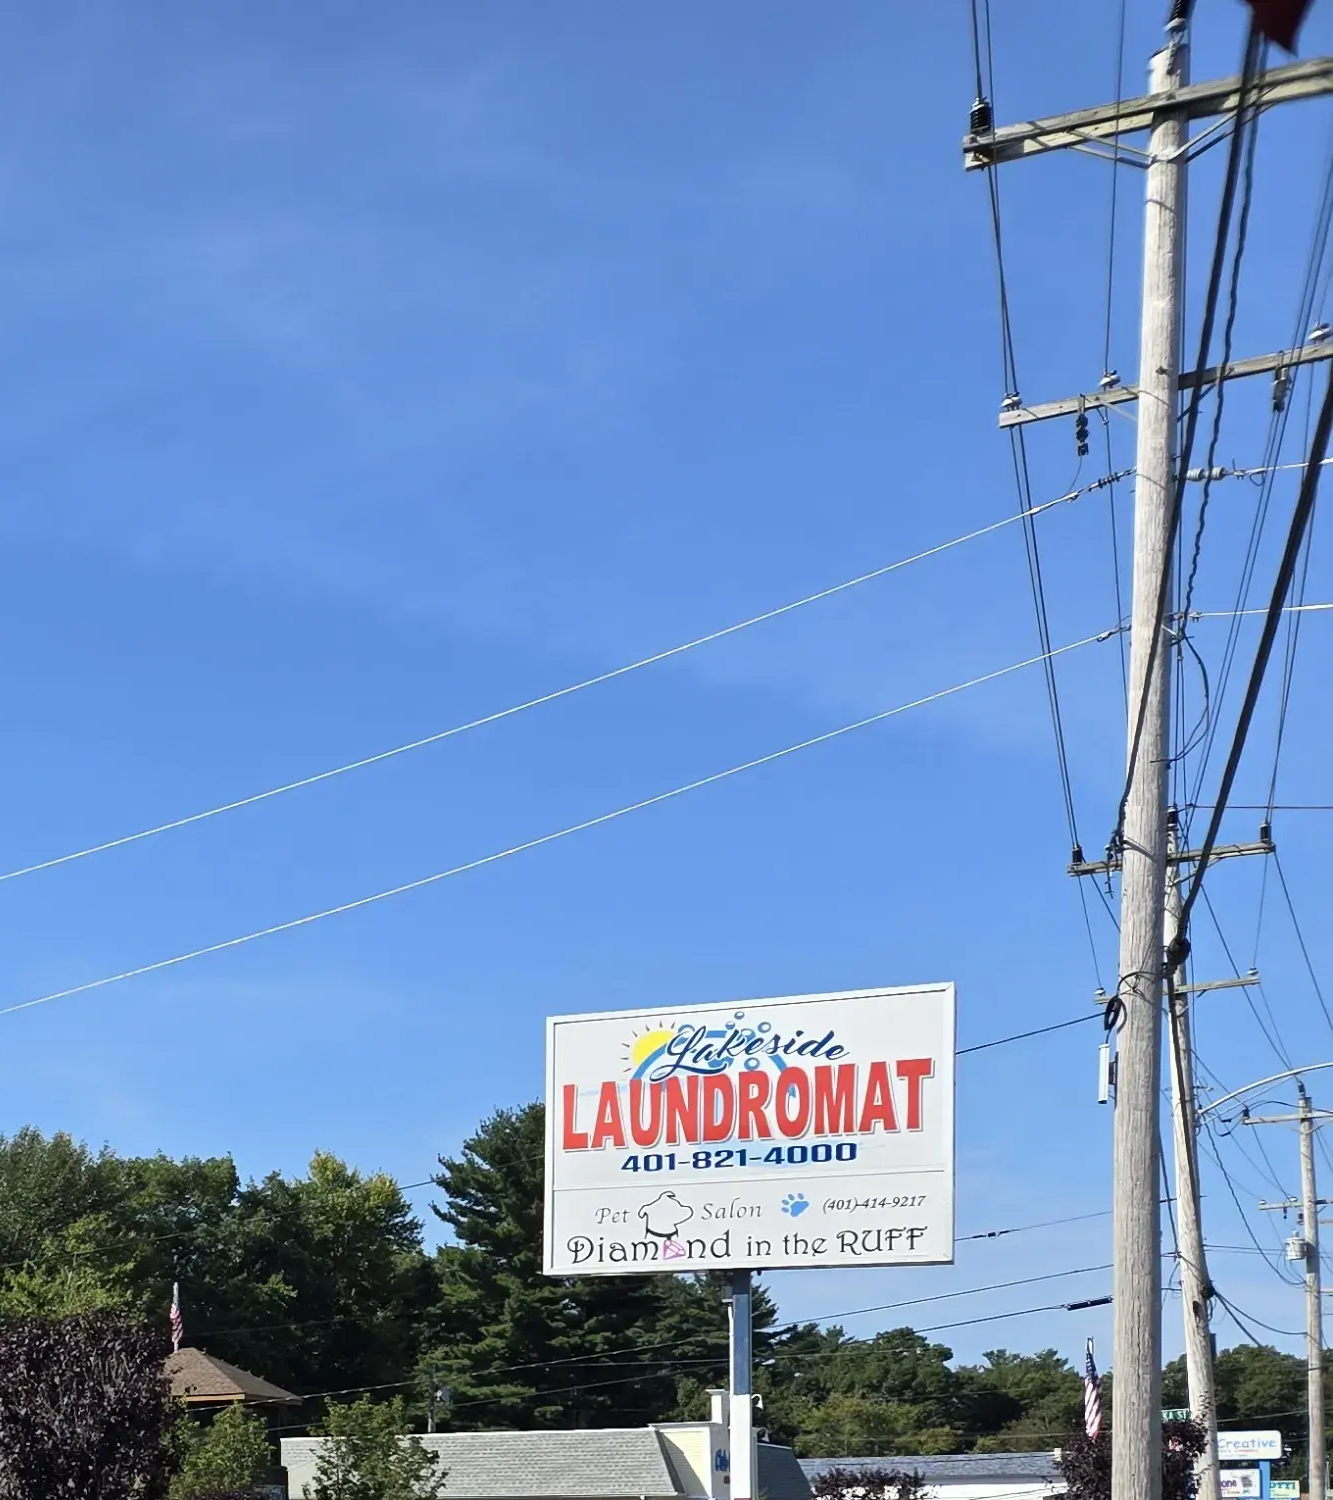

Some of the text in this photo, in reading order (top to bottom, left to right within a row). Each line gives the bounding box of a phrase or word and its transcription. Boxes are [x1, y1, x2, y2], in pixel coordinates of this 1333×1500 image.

[650, 1025, 850, 1082] Lakeside
[562, 1057, 933, 1150] LAUNDROMAT
[620, 1142, 857, 1173] 401-821-4000
[595, 1197, 763, 1225] Pet Salon
[822, 1195, 927, 1215] (401)-414-9217
[566, 1225, 929, 1265] Diamnd in the RUFF
[1218, 1437, 1277, 1449] Creative
